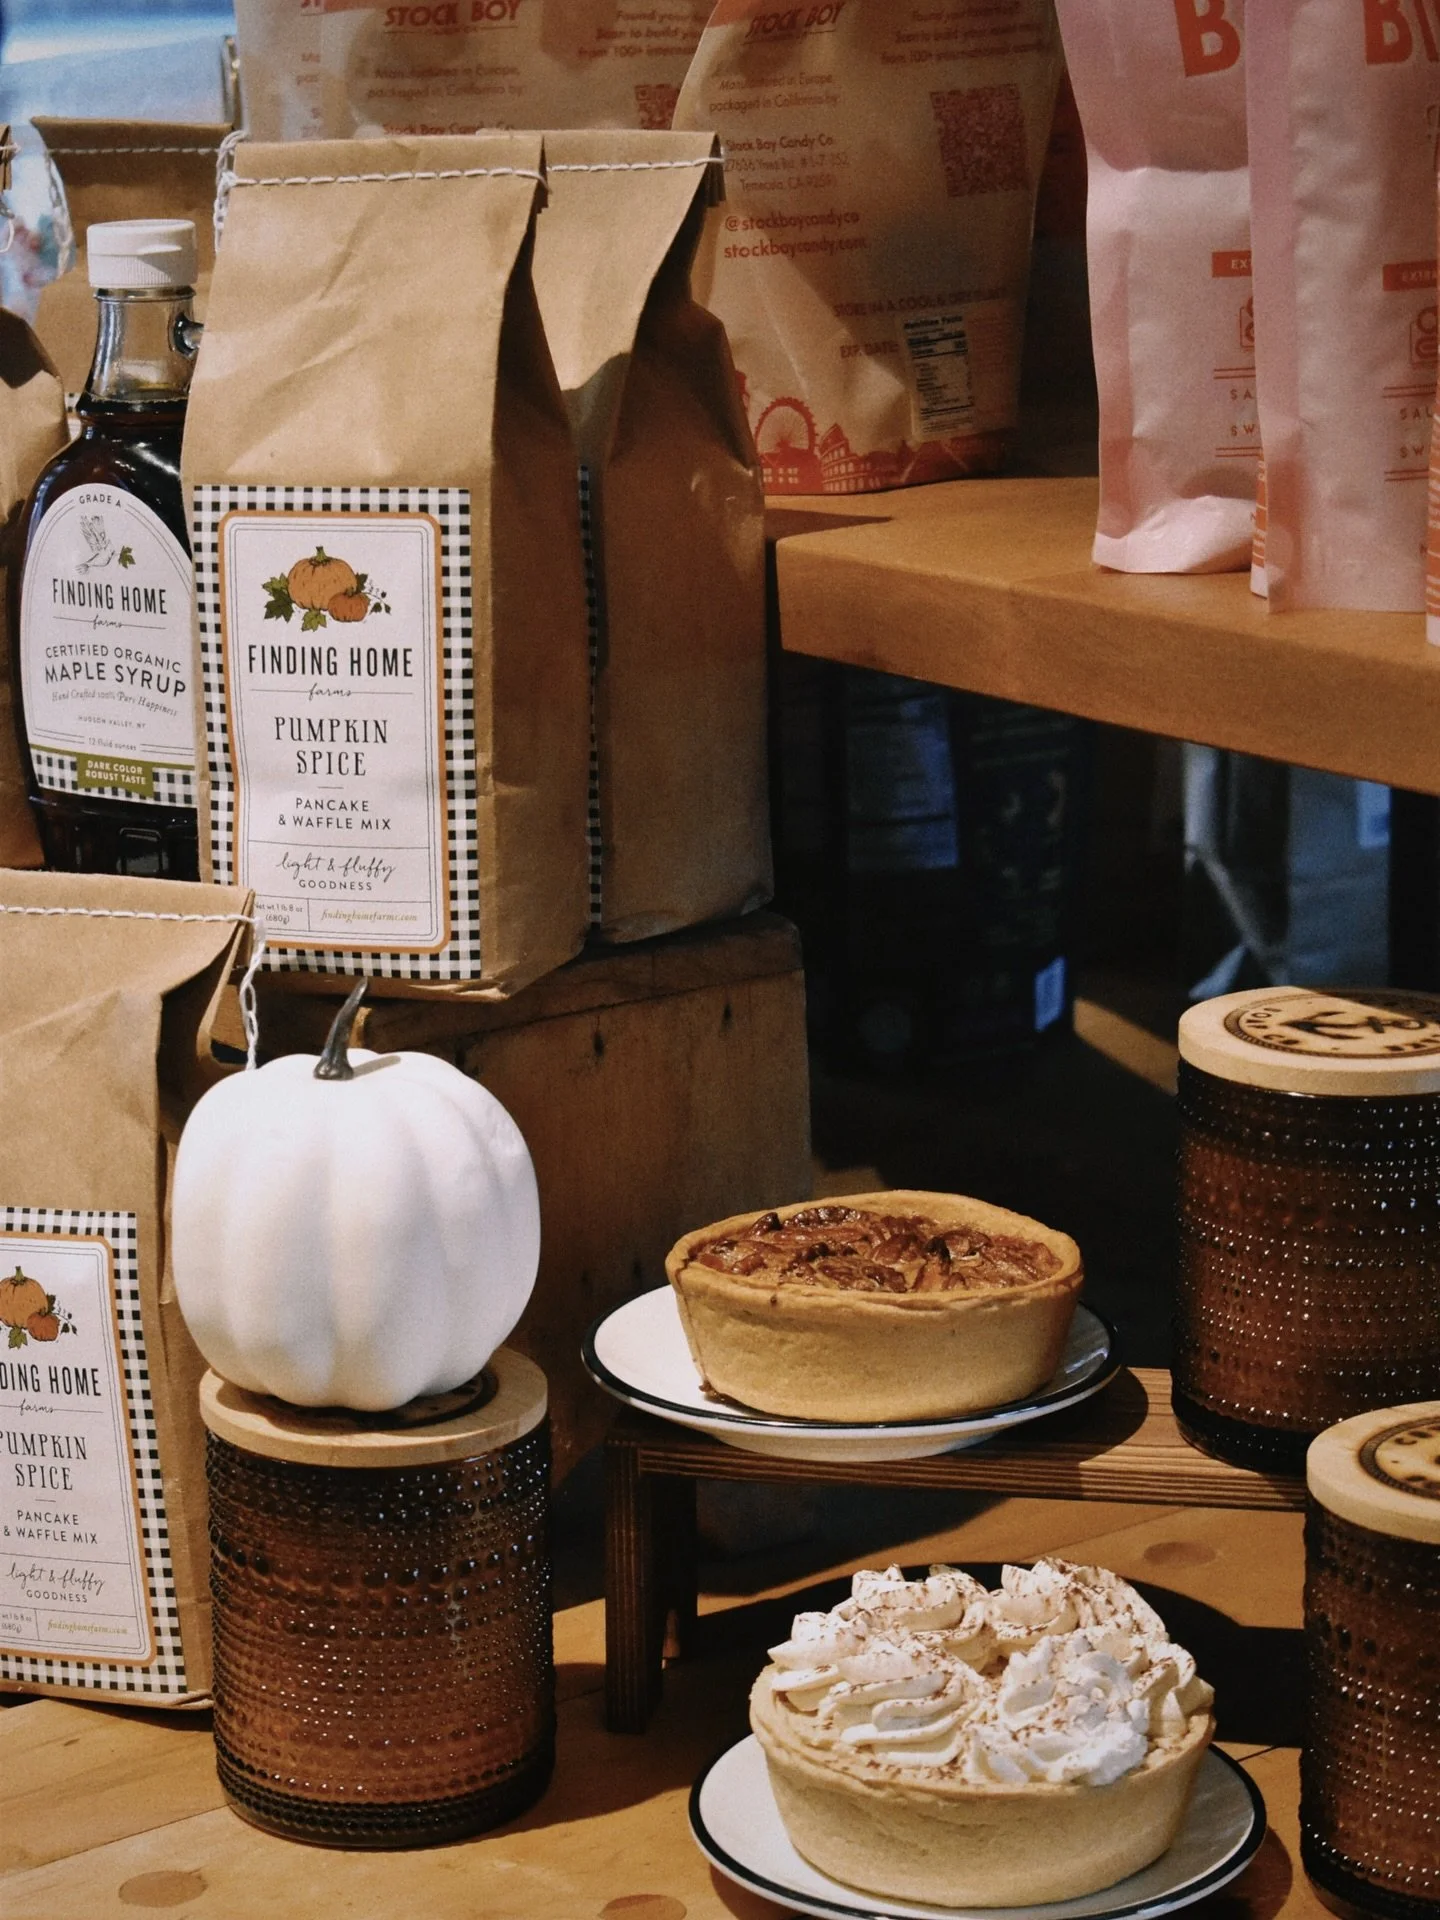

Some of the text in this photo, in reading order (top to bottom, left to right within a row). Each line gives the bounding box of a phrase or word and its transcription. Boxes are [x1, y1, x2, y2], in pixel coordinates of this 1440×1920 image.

[384, 0, 522, 27] STOCK BOY
[746, 1, 846, 37] STOCK BOY
[724, 207, 860, 232] @stockboycandyco
[79, 493, 122, 509] GRADE A
[52, 578, 168, 615] FINDING HOME
[92, 614, 123, 631] farms
[45, 644, 182, 674] CERTIFIED ORGANIC
[248, 644, 414, 677] FINDING HOME
[45, 661, 187, 699] MAPLE SYRUP
[306, 682, 353, 702] farms
[274, 716, 388, 744] PUMPKIN
[87, 759, 143, 775] DARK COLOR
[296, 750, 366, 776] SPICE
[85, 769, 146, 785] ROBUST TASTE
[295, 797, 370, 812] PANCAKE
[279, 815, 392, 830] & WAFFLE MIX
[275, 851, 397, 883] light & fluffy
[298, 879, 373, 891] GOODNESS
[265, 914, 290, 925] (680g)
[321, 909, 419, 924] findinghomefarms.com
[48, 1366, 102, 1397] HOME
[18, 1398, 55, 1416] farms
[15, 1463, 74, 1491] SPICE
[17, 1509, 80, 1525] PANCAKE
[3, 1526, 98, 1545] & WAFFLE MIX
[5, 1561, 106, 1596] light & fluffy
[26, 1589, 89, 1603] GOODNESS
